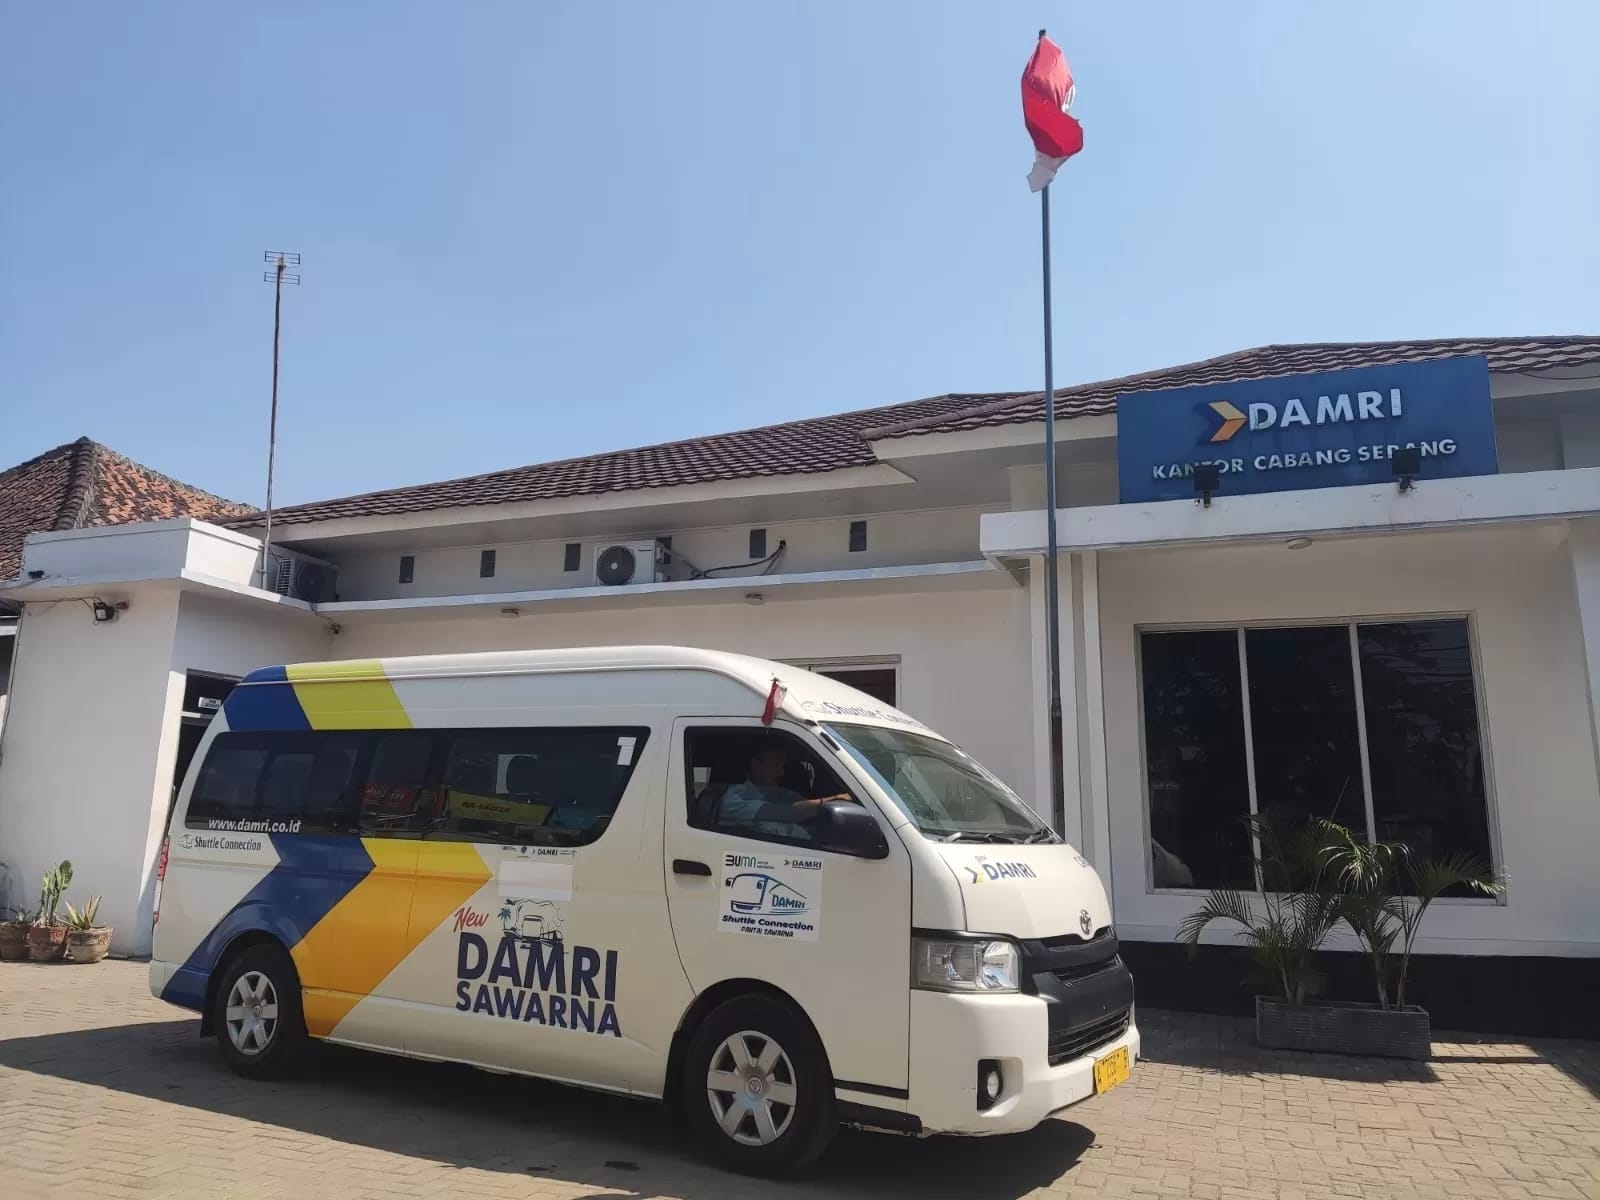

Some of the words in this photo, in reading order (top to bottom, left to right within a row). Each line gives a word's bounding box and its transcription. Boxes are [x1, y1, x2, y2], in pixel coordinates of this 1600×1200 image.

[1249, 388, 1402, 430] DAMRI
[1153, 459, 1244, 479] KANOR
[1254, 448, 1351, 470] CABANG
[616, 736, 637, 766] 1
[208, 818, 302, 833] www.damri.co.id
[194, 836, 219, 849] Shuttle
[220, 837, 262, 851] Connection
[792, 860, 822, 868] DAMRI
[982, 861, 1037, 881] DAMRI
[772, 894, 805, 908] DAMRI
[453, 906, 489, 933] New
[722, 915, 755, 924] Shuttle
[758, 918, 814, 931] Connection
[741, 926, 762, 934] PANTAI
[764, 929, 793, 938] SAWARNA
[456, 931, 619, 1003] DAMRI
[455, 981, 622, 1038] SAWARNA
